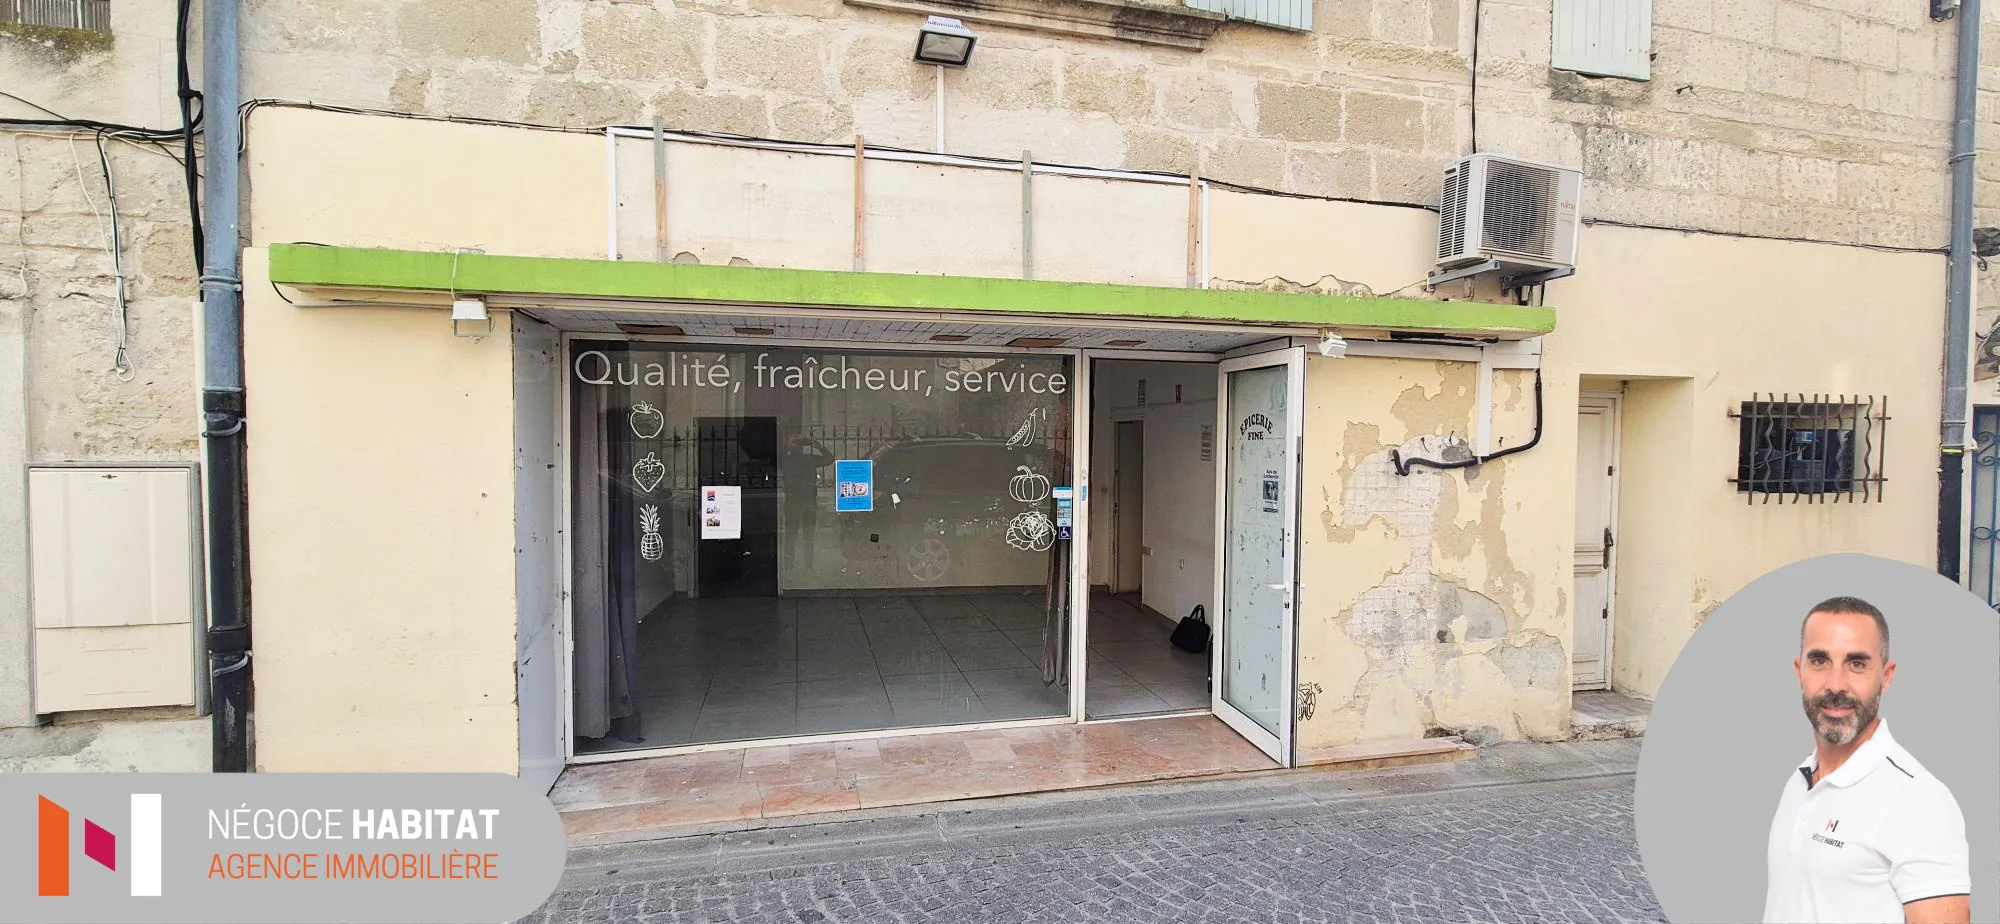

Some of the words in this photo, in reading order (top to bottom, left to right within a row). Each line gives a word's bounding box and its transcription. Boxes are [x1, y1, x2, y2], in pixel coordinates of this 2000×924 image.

[574, 350, 741, 393] Qualité,
[753, 352, 932, 397] fraîcheur,
[944, 363, 1067, 394] service
[1240, 413, 1273, 436] EPICERIE
[1247, 431, 1264, 441] FINE
